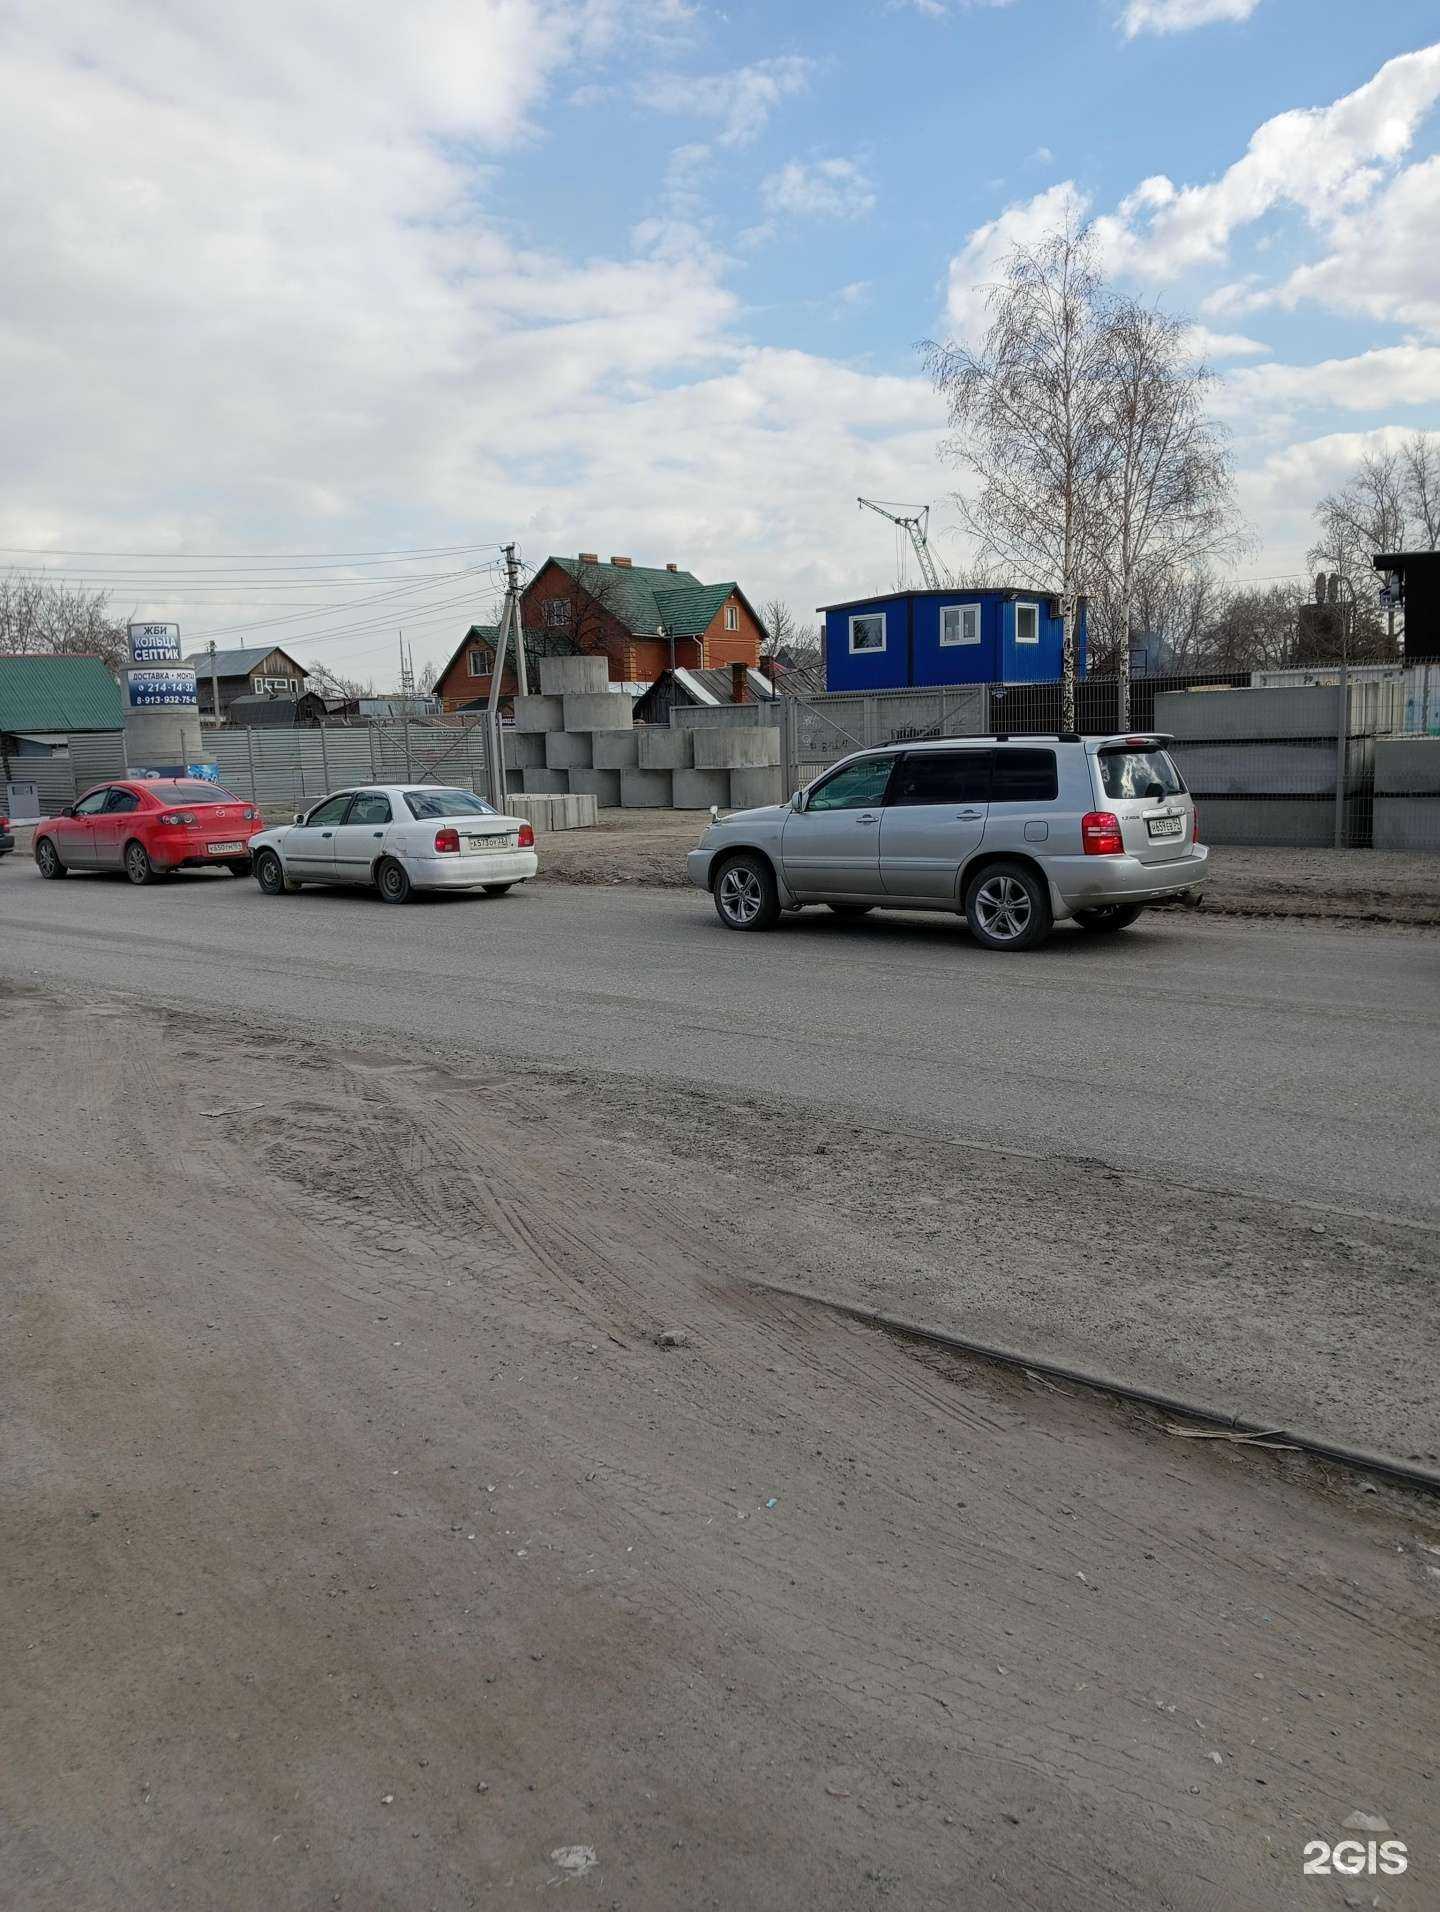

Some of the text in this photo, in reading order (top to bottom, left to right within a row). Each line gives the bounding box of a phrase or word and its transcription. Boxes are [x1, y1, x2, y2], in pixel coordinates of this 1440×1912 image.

[143, 626, 168, 635] ЖБИ
[135, 637, 177, 649] КОЛЬЦА
[134, 648, 179, 661] СЕПТИК
[133, 672, 170, 681] ДОСТАВКА
[147, 682, 194, 692] 214-14-32
